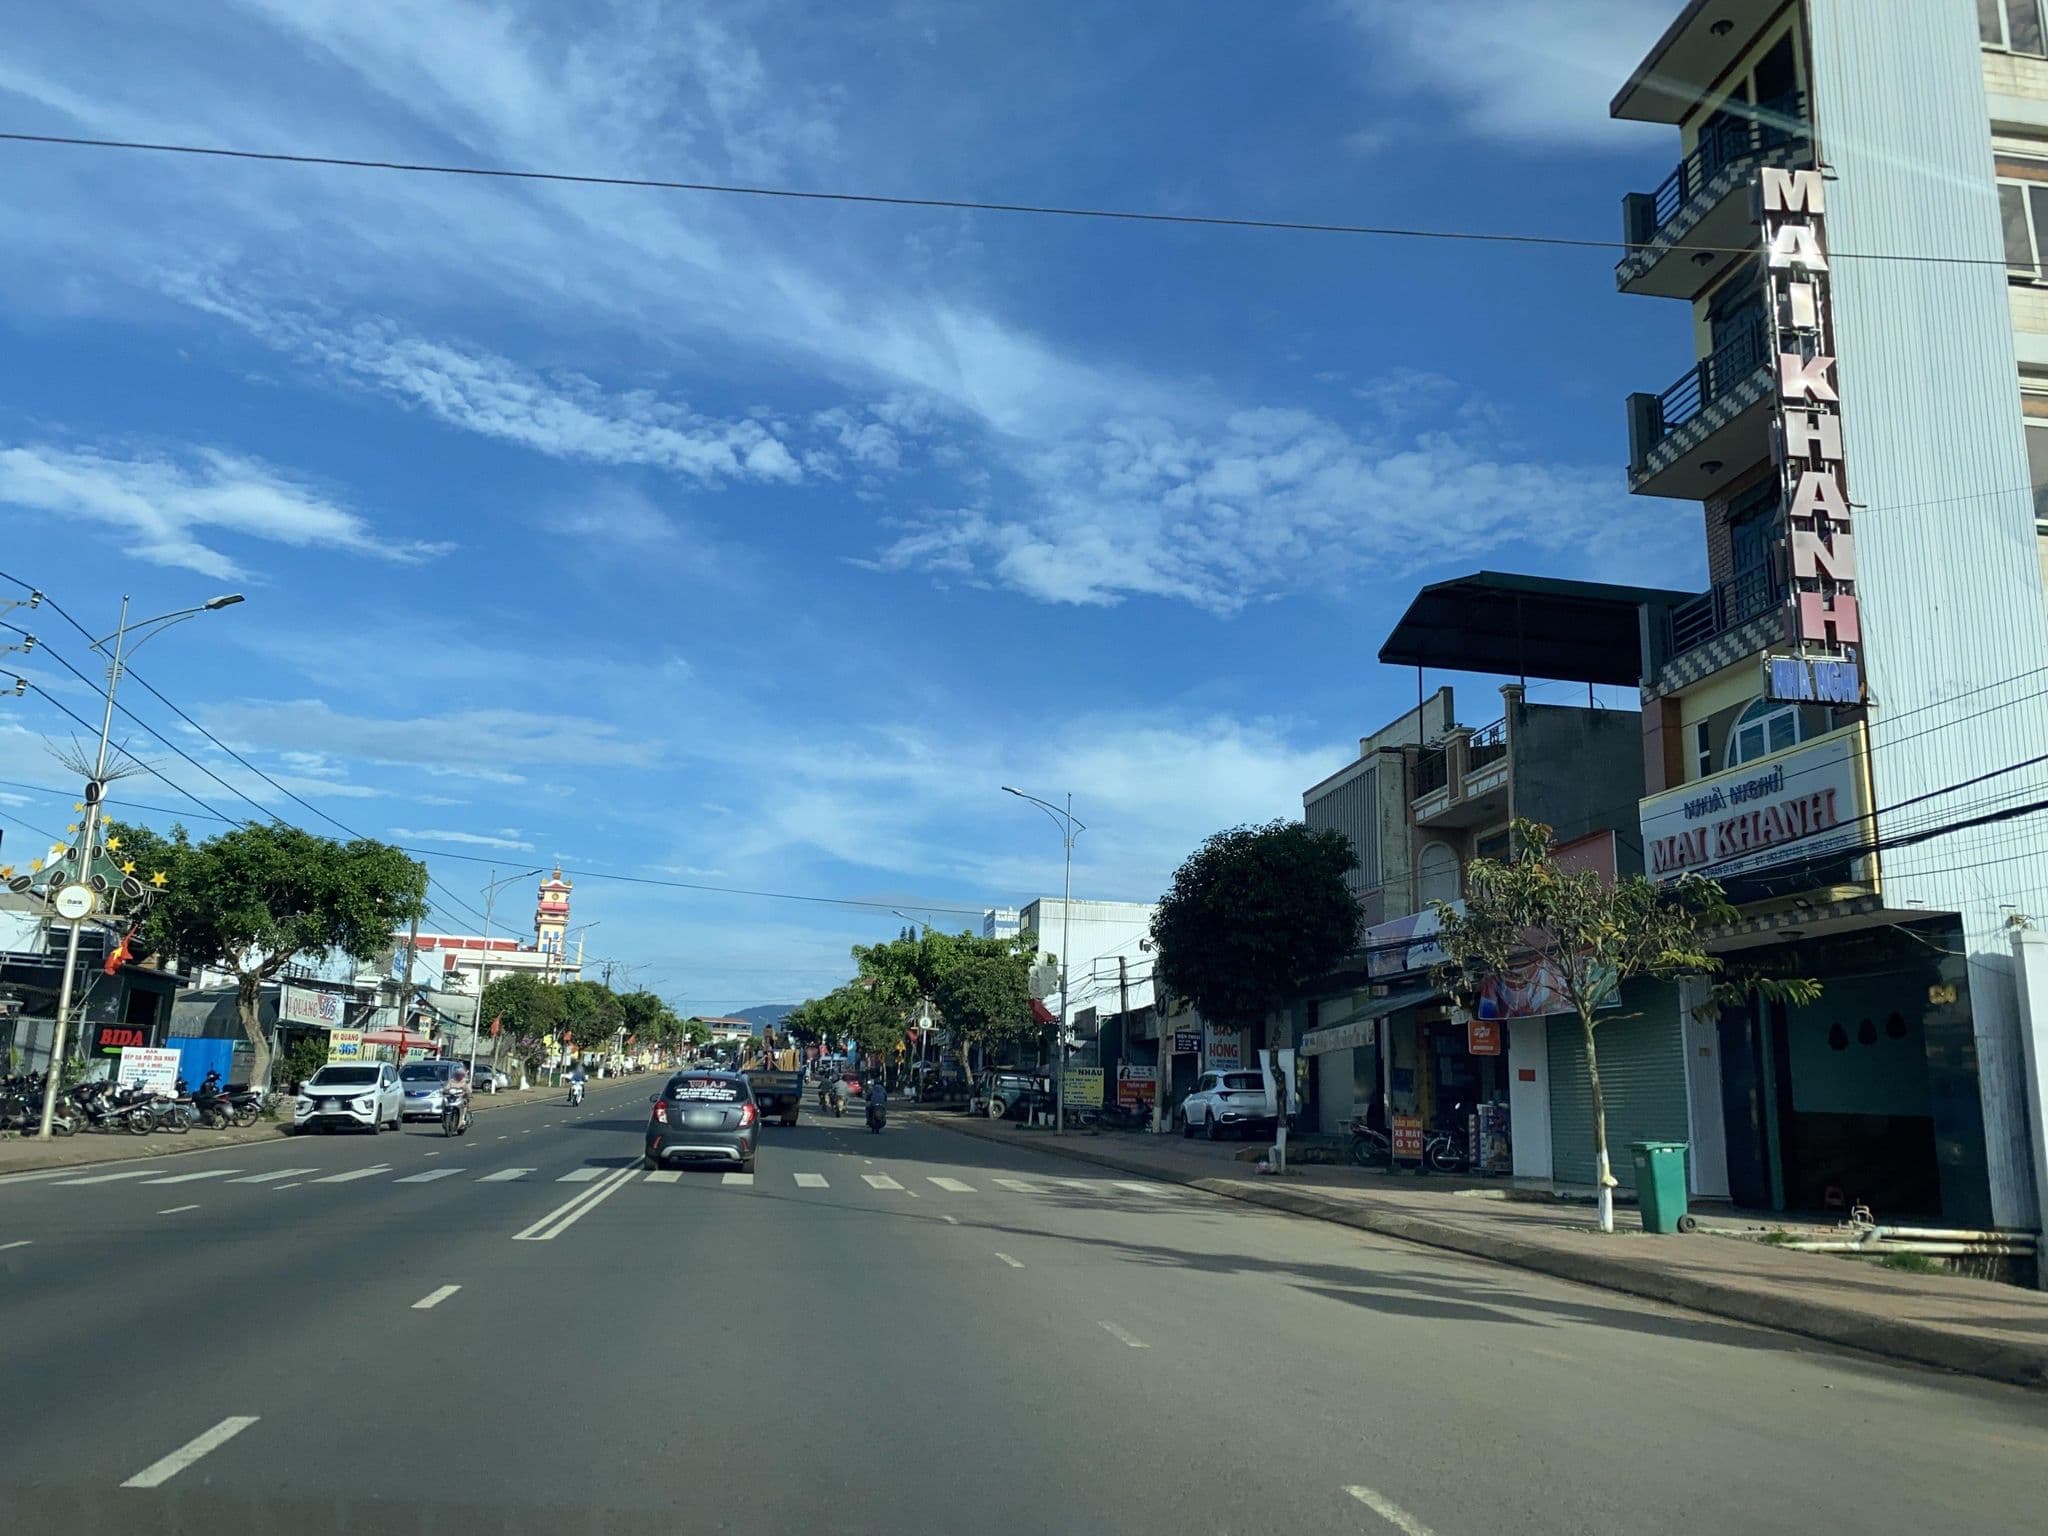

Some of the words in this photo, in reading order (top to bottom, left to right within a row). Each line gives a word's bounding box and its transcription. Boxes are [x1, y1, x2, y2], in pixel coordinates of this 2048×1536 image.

[1762, 167, 1828, 329] MAI
[1778, 353, 1860, 643] KHANH
[1650, 827, 1709, 874] MAI
[1712, 788, 1839, 858] KHANH
[100, 1029, 144, 1046] BIDA
